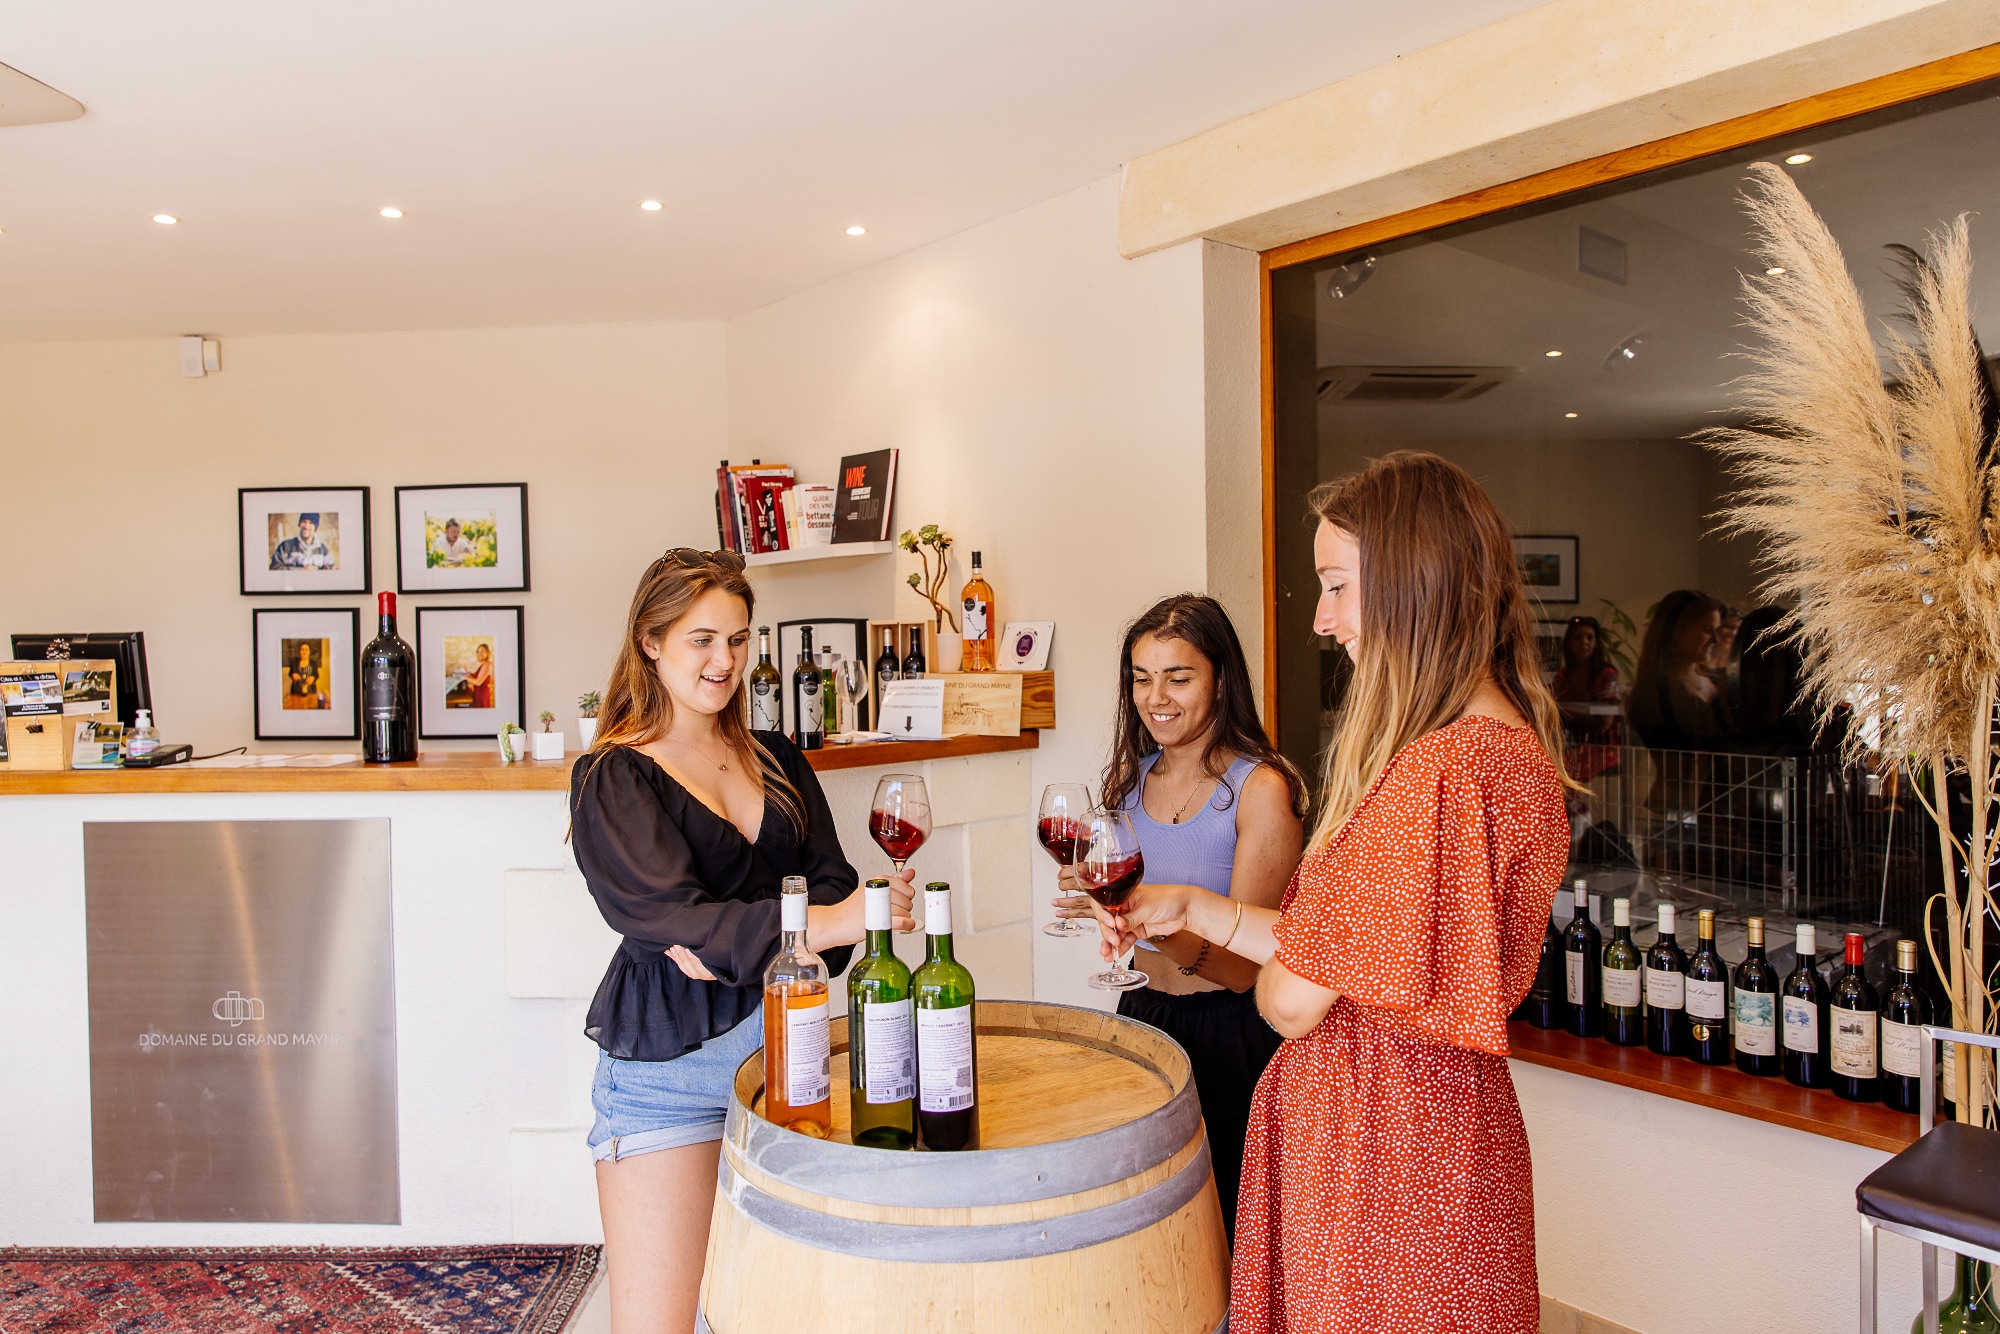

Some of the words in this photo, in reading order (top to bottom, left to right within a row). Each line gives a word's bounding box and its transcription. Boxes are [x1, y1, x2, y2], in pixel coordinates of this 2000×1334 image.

[845, 465, 867, 489] WINE
[812, 495, 830, 503] GUIDE
[805, 511, 831, 520] bettane
[858, 498, 879, 521] TOUR
[139, 1033, 208, 1047] DOMAINE
[212, 1033, 234, 1047] DU
[236, 1033, 289, 1047] GRAND
[292, 1033, 342, 1047] MAYNE
